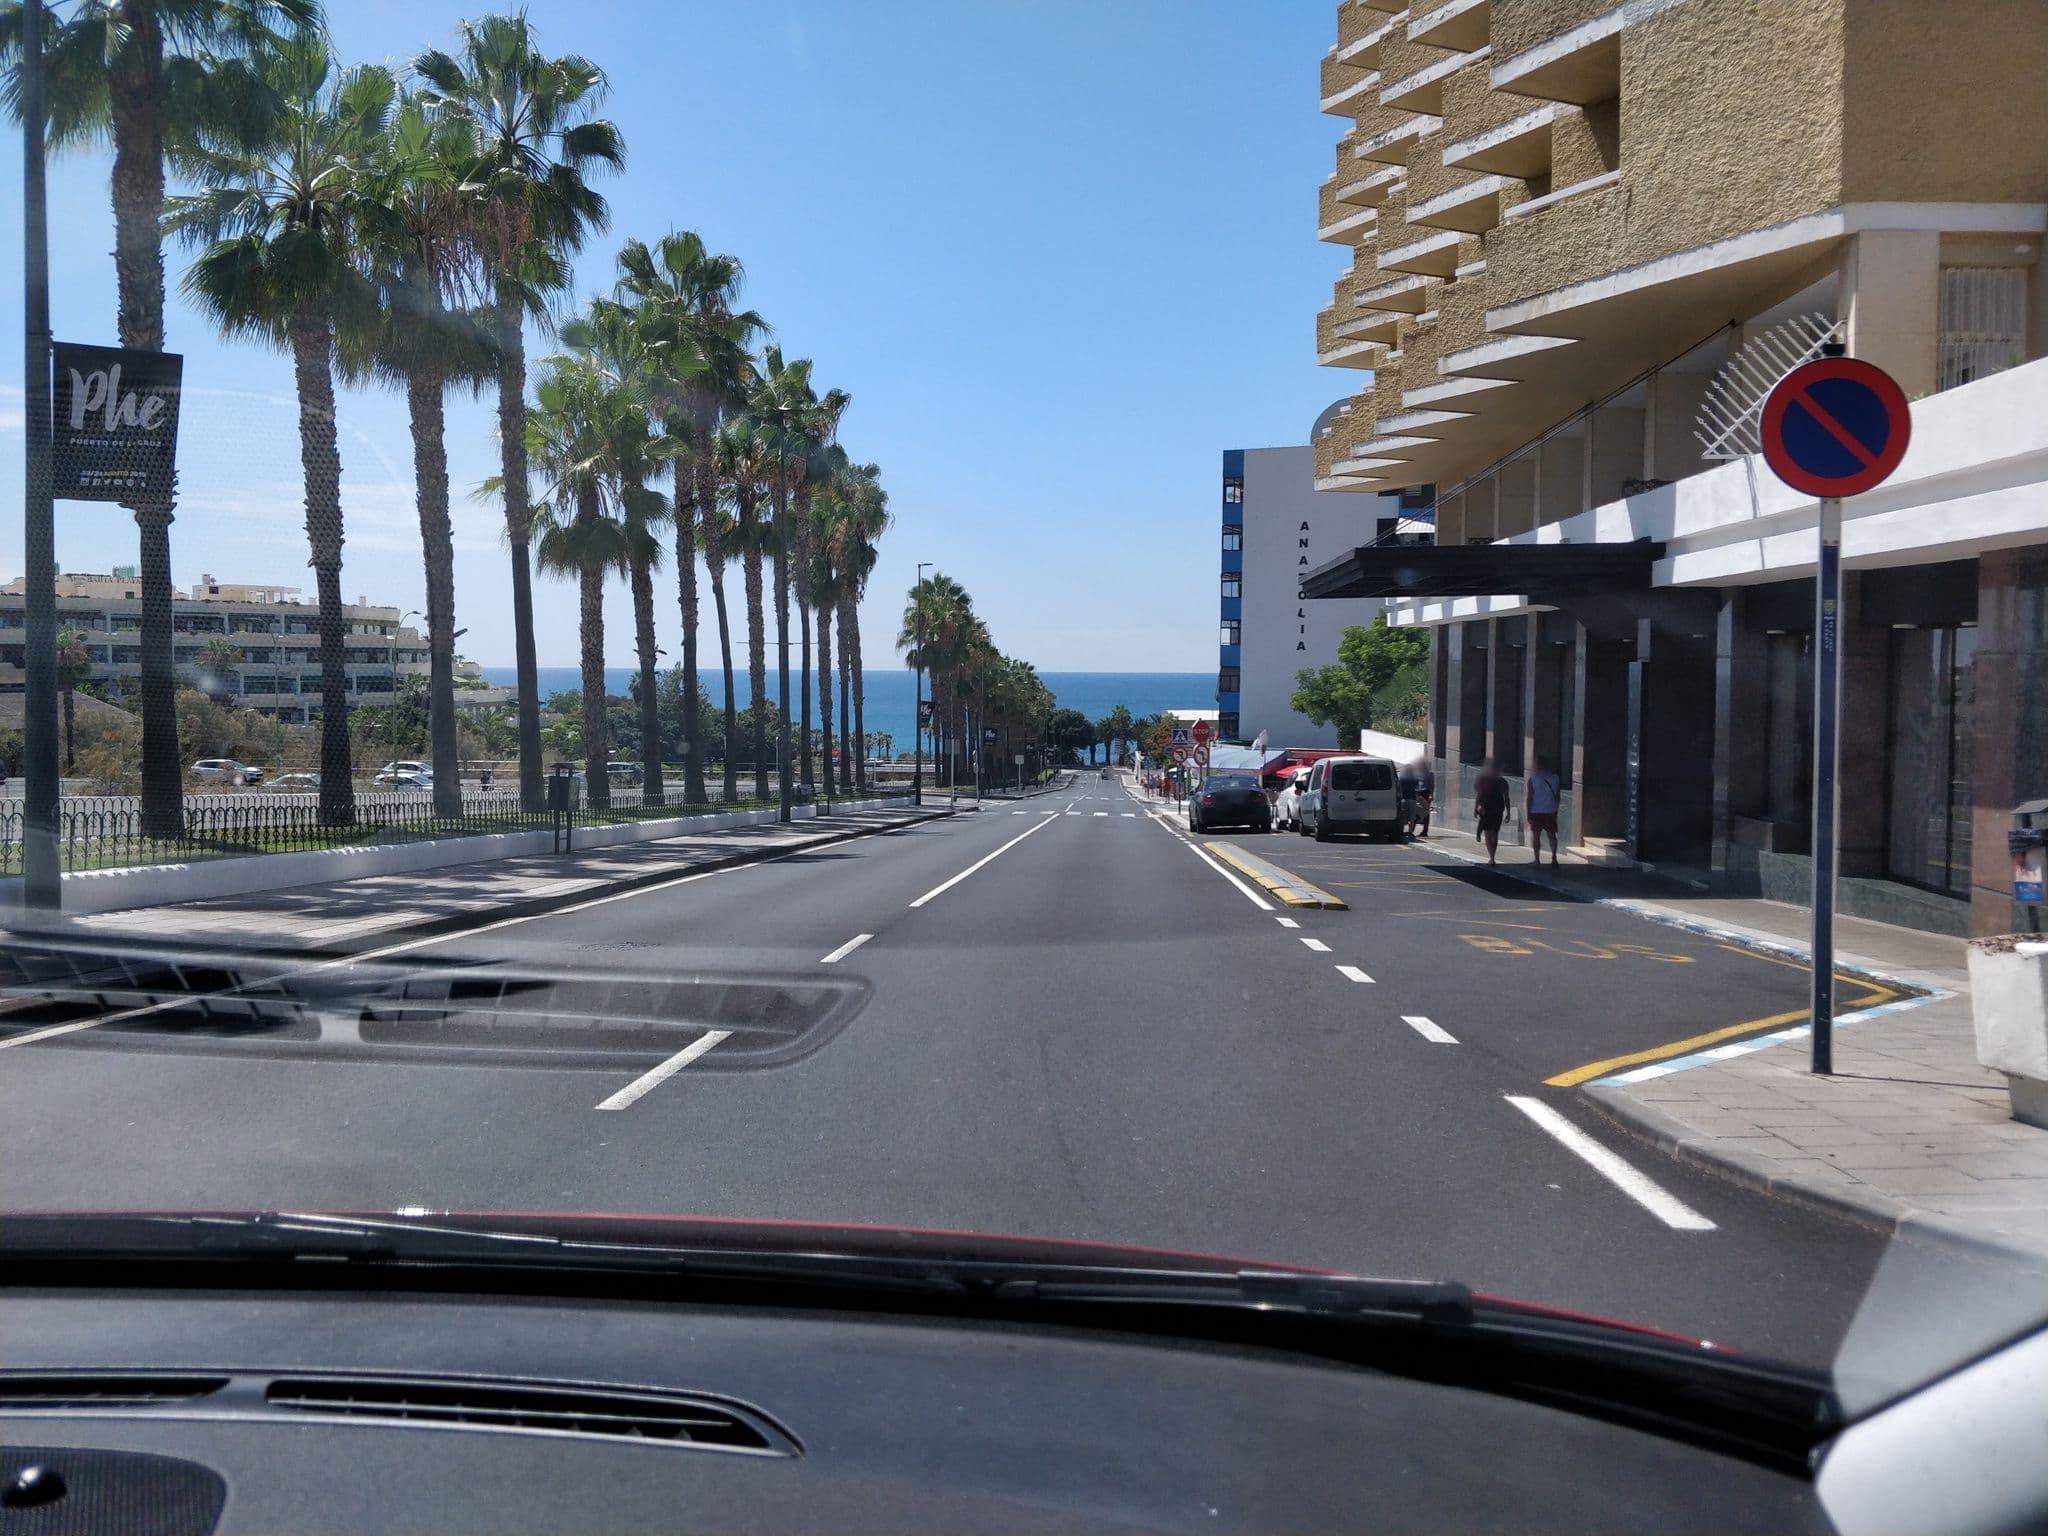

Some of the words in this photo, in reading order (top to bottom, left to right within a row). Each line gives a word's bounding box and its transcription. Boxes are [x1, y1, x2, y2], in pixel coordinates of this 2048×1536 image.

[70, 362, 166, 432] Phe
[70, 437, 109, 447] PUERTO
[112, 439, 125, 447] DE
[137, 439, 162, 448] CRUZ
[1193, 728, 1210, 736] STOP
[1456, 933, 1698, 965] BUS
